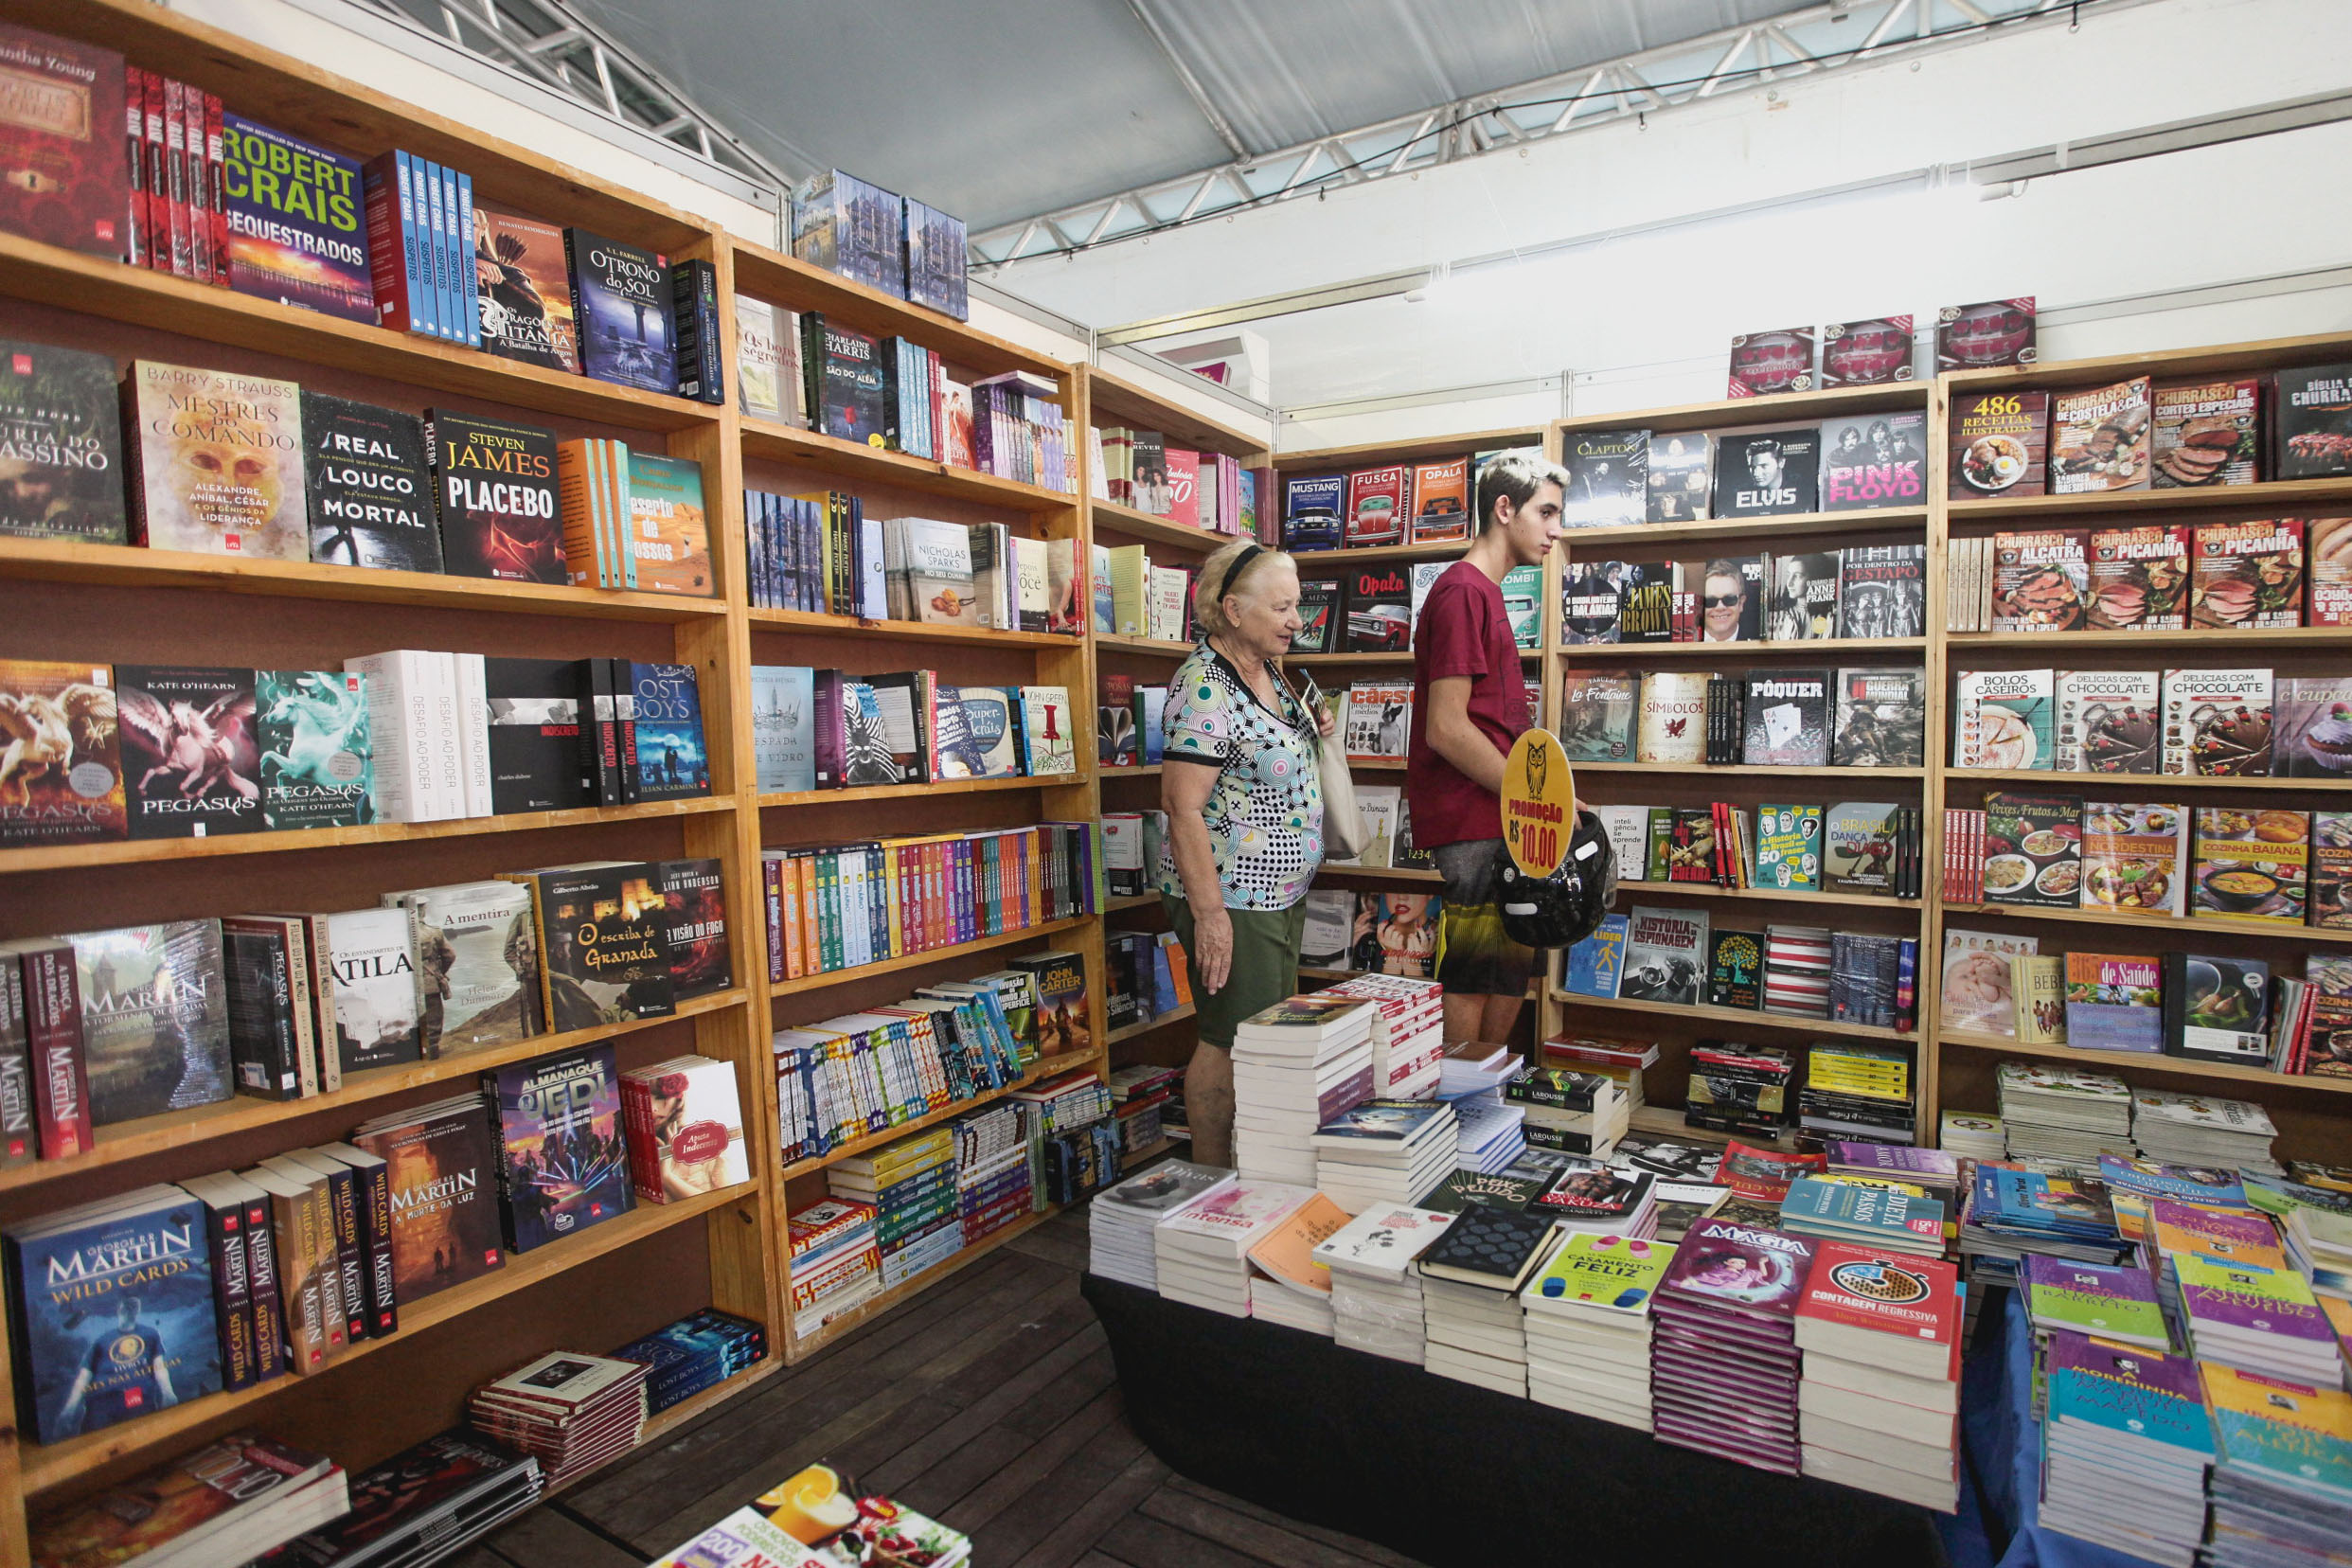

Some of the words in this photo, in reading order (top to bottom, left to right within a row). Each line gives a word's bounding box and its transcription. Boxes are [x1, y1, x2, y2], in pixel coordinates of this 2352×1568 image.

[45, 55, 95, 81] Young
[224, 126, 355, 196] ROBERT
[400, 165, 410, 201] ROBERT
[415, 171, 425, 206] ROBERT
[225, 159, 357, 232] CRAIS
[431, 176, 441, 211] ROBERT
[446, 182, 456, 217] ROBERT
[402, 202, 413, 222] CRAIS
[419, 207, 427, 226] CRAIS
[434, 212, 443, 231] CRAIS
[743, 330, 759, 346] Os
[762, 339, 798, 359] bons
[742, 345, 799, 369] segredos
[148, 366, 210, 387] BARRY
[215, 374, 293, 398] STRAUSS
[844, 369, 855, 378] DO
[2155, 385, 2236, 405] CHURRASCO
[2236, 388, 2251, 399] DE
[2307, 379, 2343, 391] BÍBLIA
[167, 393, 279, 423] MESTRES
[1972, 395, 2022, 417] 486
[2155, 402, 2198, 416] CORTES
[2199, 397, 2254, 413] ESPECIAIS
[212, 417, 238, 427] DO
[1962, 424, 2033, 436] ILUSTRADAS
[1964, 414, 2032, 427] RECEITAS
[151, 419, 295, 451] COMANDO
[424, 421, 437, 467] PLACEBO
[469, 432, 525, 451] STEVEN
[1577, 442, 1636, 455] CLAPTON
[446, 440, 551, 479] JAMES
[327, 466, 416, 498] LOUCO,
[1357, 472, 1398, 486] FUSCA
[1425, 466, 1462, 480] OPALA
[1828, 459, 1921, 489] PINK
[1292, 482, 1339, 493] MUSTANG
[1828, 481, 1921, 503] FLOYD
[234, 493, 270, 507] CÉSAR
[447, 476, 554, 520] PLACEBO
[1736, 488, 1797, 508] ELVIS
[200, 513, 262, 526] LIDERANÇA
[323, 500, 425, 529] MORTAL
[642, 518, 659, 539] de
[2092, 529, 2164, 546] CHURRASCO
[1996, 533, 2064, 548] CHURRASCO
[2065, 537, 2077, 546] DE
[2117, 541, 2185, 559] PICANHA
[2224, 535, 2299, 554] PICANHA
[918, 545, 967, 559] NICHOLAS
[2021, 545, 2084, 559] ALCATRA
[928, 557, 960, 569] SPARKS
[1843, 565, 1919, 580] GESTAPO
[935, 571, 947, 579] SEU
[947, 571, 966, 580] OLHAR
[1359, 572, 1405, 597] Opala
[1629, 585, 1671, 610] JAMES
[1806, 582, 1836, 596] ANNE
[1806, 591, 1836, 603] FRANK
[1622, 609, 1670, 633] BROWN
[148, 681, 179, 690] KATE
[182, 681, 237, 690] O'HEARN
[1751, 679, 1824, 698] PÔQUER
[1984, 674, 2029, 686] BOLOS
[2119, 674, 2143, 683] COM
[2172, 682, 2265, 694] CHOCOLATE
[2226, 674, 2254, 683] COM
[1351, 687, 1409, 704] cães
[1587, 686, 1632, 702] Fontaine
[1975, 684, 2037, 695] CASEIROS
[2067, 683, 2151, 695] CHOCOLATE
[413, 695, 425, 738] DESAFIO
[438, 695, 453, 738] DESAFIO
[633, 699, 689, 719] BOYS
[1647, 701, 1704, 714] SÍMBOLOS
[541, 724, 579, 737] INDISCRETO
[601, 722, 615, 767] INDISCRETO
[623, 722, 636, 766] INDISCRETO
[769, 753, 803, 762] VIDRO
[417, 754, 431, 792] PODER
[443, 752, 456, 789] PODER
[473, 750, 485, 788] PODER
[267, 783, 365, 801] PEGASUS
[143, 796, 257, 816] PEGASUS
[279, 804, 306, 812] KATE
[1508, 798, 1562, 824] PROMOÇÃO
[1989, 802, 2017, 815] Peixes
[2021, 805, 2053, 818] Frutos
[2059, 807, 2081, 819] Mar
[1841, 819, 1890, 833] BRASIL
[1522, 824, 1557, 869] 10,00
[1831, 831, 1867, 843] DANÇA
[1758, 850, 1780, 864] 50
[2089, 841, 2175, 854] NORDESTINA
[2203, 843, 2250, 854] COZINHA
[2252, 844, 2302, 857] BAIANA
[552, 885, 578, 895] Gilberto
[579, 882, 599, 892] Abrão
[444, 913, 458, 925] A
[460, 908, 511, 923] mentira
[577, 922, 598, 947] O
[599, 931, 642, 944] escriba
[643, 927, 655, 938] de
[706, 919, 724, 935] FOGO
[1594, 930, 1622, 941] LÍDER
[1633, 931, 1696, 949] ESPIONAGEM
[45, 954, 53, 972] DOS
[273, 951, 288, 1006] PEGASUS
[1040, 976, 1080, 992] CARTER
[1046, 968, 1073, 982] JOHN
[2101, 962, 2116, 984] de
[2119, 962, 2157, 987] Saúde
[468, 985, 497, 996] Helen
[48, 1046, 79, 1121] MARTIN
[522, 1060, 603, 1094] ALMANAQUE
[1, 1055, 29, 1132] MARTIN
[1531, 1091, 1565, 1101] LAROUSSE
[1529, 1131, 1562, 1143] LAROUSSE
[1164, 1165, 1218, 1183] Divas
[390, 1167, 477, 1213] MARTIN
[406, 1205, 437, 1221] MORTE
[456, 1190, 475, 1204] LUZ
[1544, 1194, 1624, 1211] YAKUZA
[1854, 1190, 1878, 1221] PASSOS
[1882, 1195, 1909, 1225] DIETA
[1702, 1223, 1810, 1257] MAGIA
[46, 1224, 190, 1285] MARTIN
[250, 1229, 272, 1288] MARTIN
[1567, 1253, 1653, 1272] CASAMENTO
[224, 1236, 246, 1294] MARTIN
[1573, 1260, 1644, 1278] FELIZ
[51, 1277, 112, 1306] WILD
[117, 1258, 189, 1285] CARDS
[343, 1260, 363, 1316] MARTIN
[375, 1253, 393, 1308] MARTIN
[323, 1271, 343, 1326] MARTIN
[1811, 1290, 1876, 1310] CONTAGEM
[1878, 1304, 1937, 1323] REGRESSIVA
[258, 1304, 268, 1339] CARDS
[304, 1287, 323, 1345] MARTIN
[228, 1312, 241, 1351] CARDS
[261, 1340, 272, 1372] WILD
[231, 1353, 244, 1384] WILD
[2072, 1364, 2189, 1401] MORENINHA
[700, 1532, 744, 1560] 200
